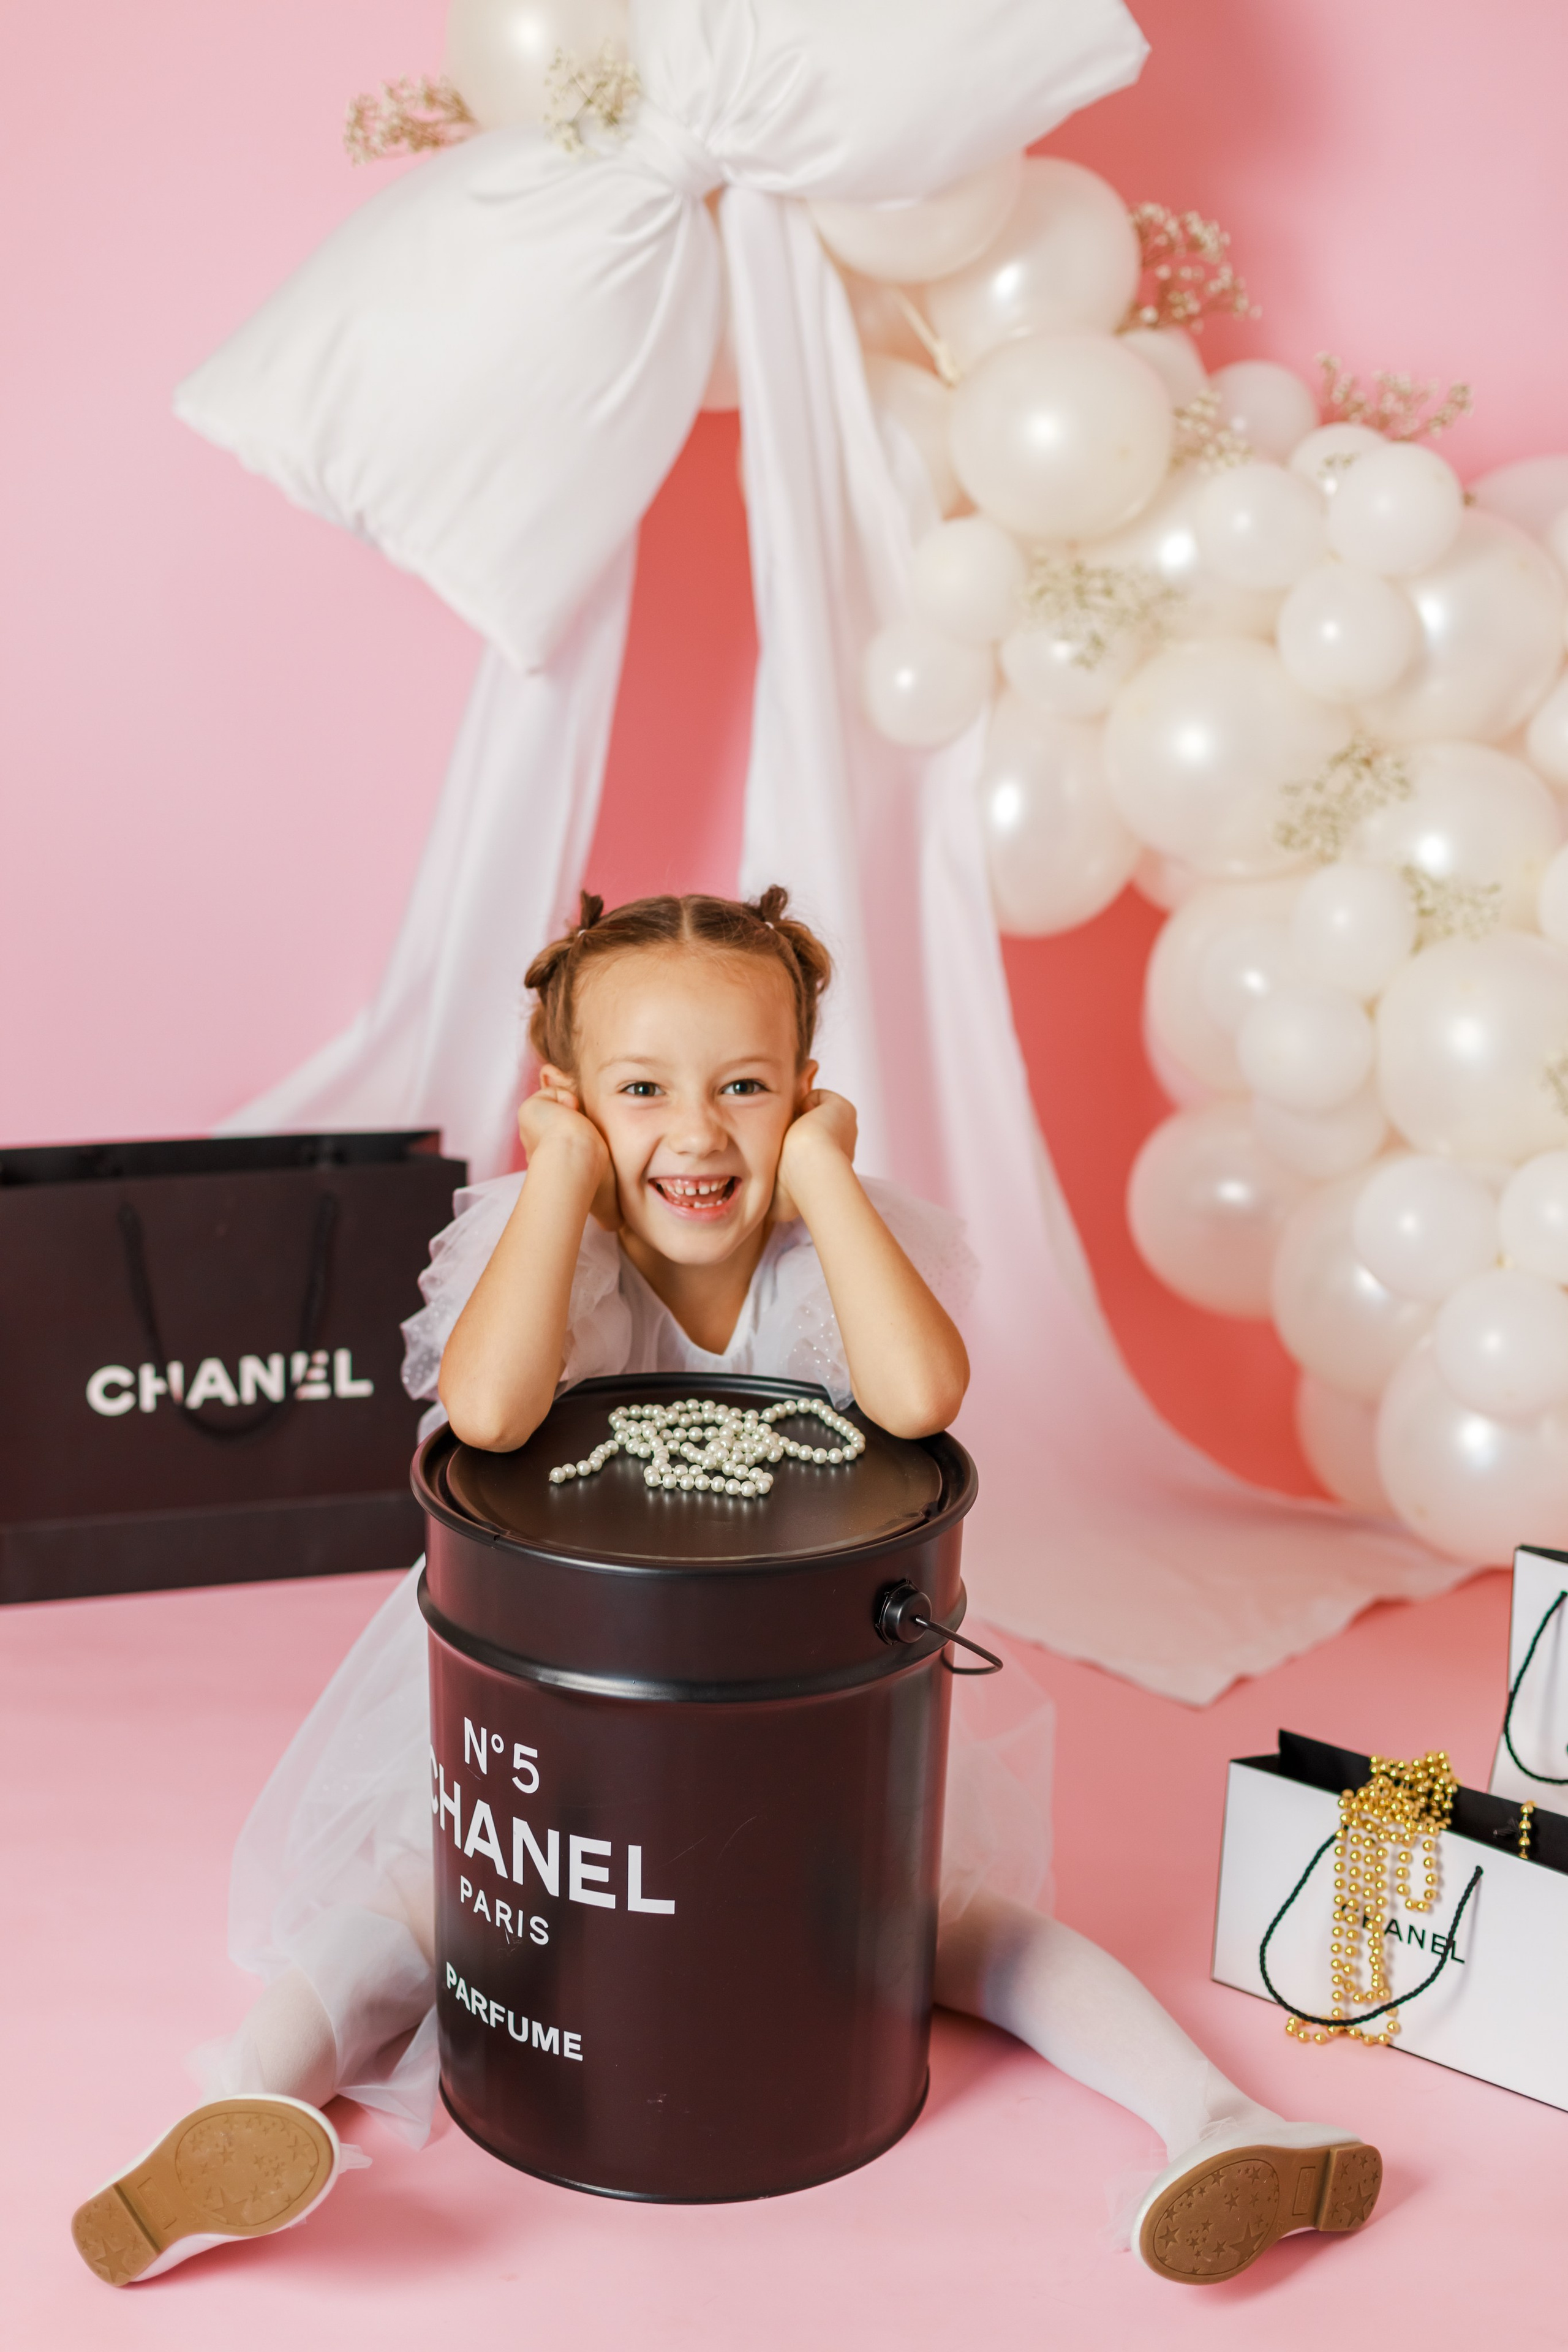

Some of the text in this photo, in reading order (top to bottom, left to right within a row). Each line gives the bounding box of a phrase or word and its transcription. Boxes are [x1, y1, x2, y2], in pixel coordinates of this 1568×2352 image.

[86, 1348, 374, 1416] CHANEL
[429, 1744, 676, 1915] CHANEL
[460, 1875, 549, 1945] PARIS
[1340, 1904, 1465, 1964] ANEL
[446, 1961, 583, 2062] PARFUME
